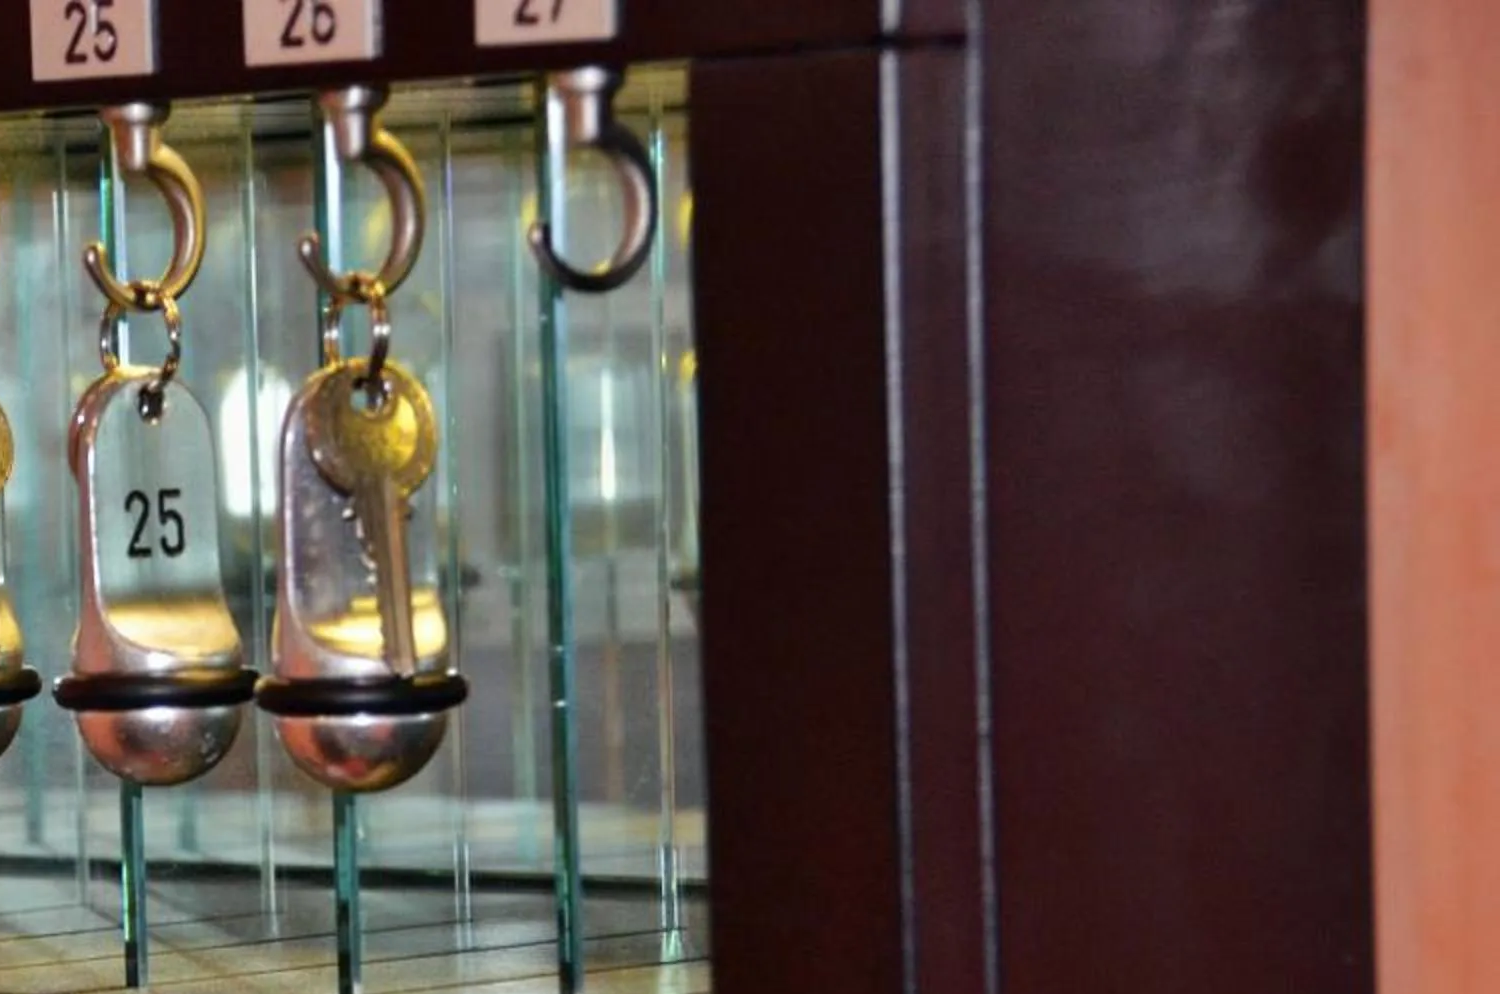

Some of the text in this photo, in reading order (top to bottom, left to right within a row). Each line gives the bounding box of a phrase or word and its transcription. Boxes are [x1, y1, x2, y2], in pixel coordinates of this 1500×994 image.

[64, 0, 118, 65] 25
[279, 0, 337, 49] 26
[124, 488, 186, 559] 25
